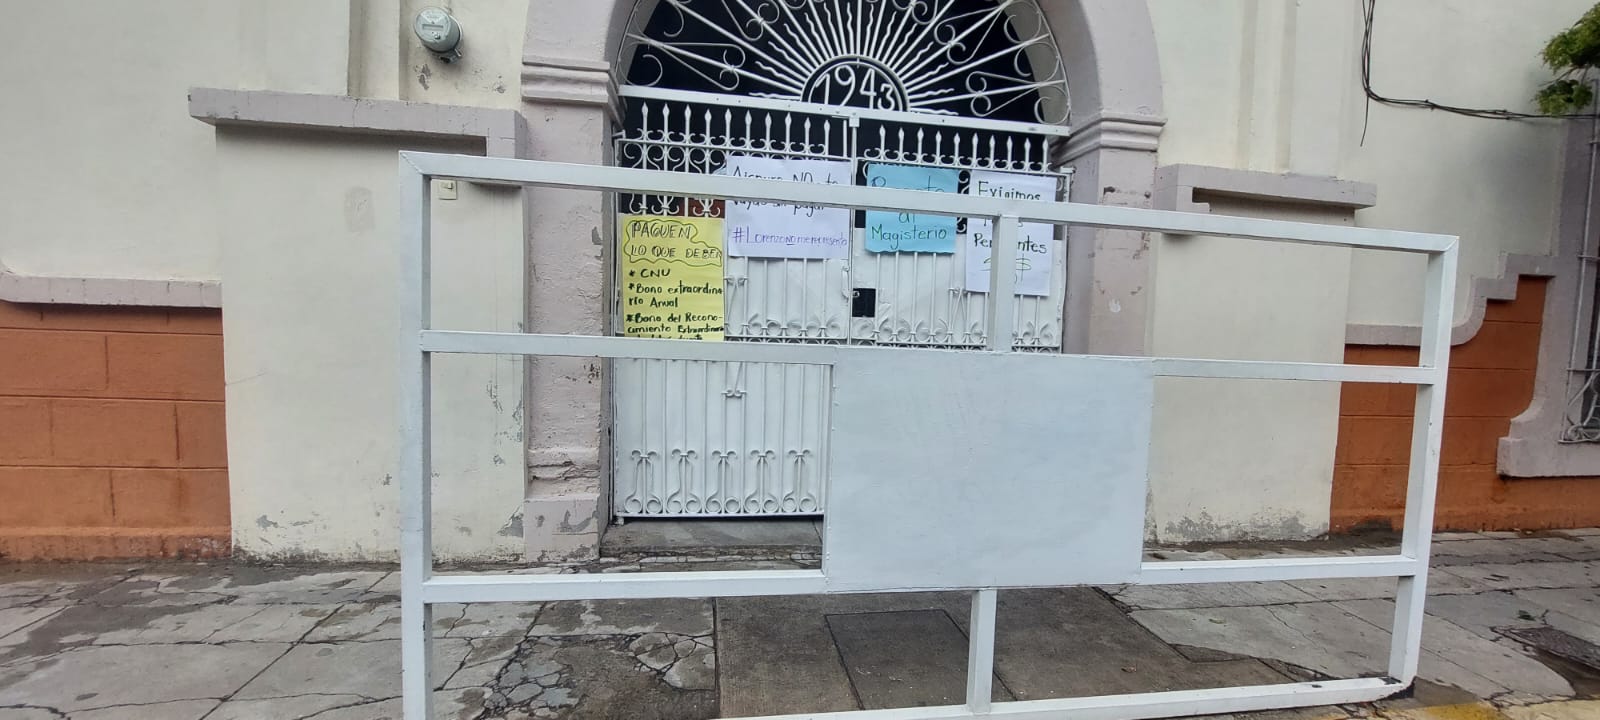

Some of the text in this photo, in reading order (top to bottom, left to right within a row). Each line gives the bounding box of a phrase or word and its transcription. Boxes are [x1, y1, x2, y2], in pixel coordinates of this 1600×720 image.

[815, 65, 895, 111] 1943
[631, 222, 691, 239] PAGUEN
[871, 223, 947, 250] Magisterio
[973, 232, 1047, 254] Pentes
[631, 244, 647, 257] LO
[652, 245, 676, 258] QUE
[640, 268, 671, 278] CNU
[650, 297, 678, 308] Anual
[667, 313, 681, 323] del
